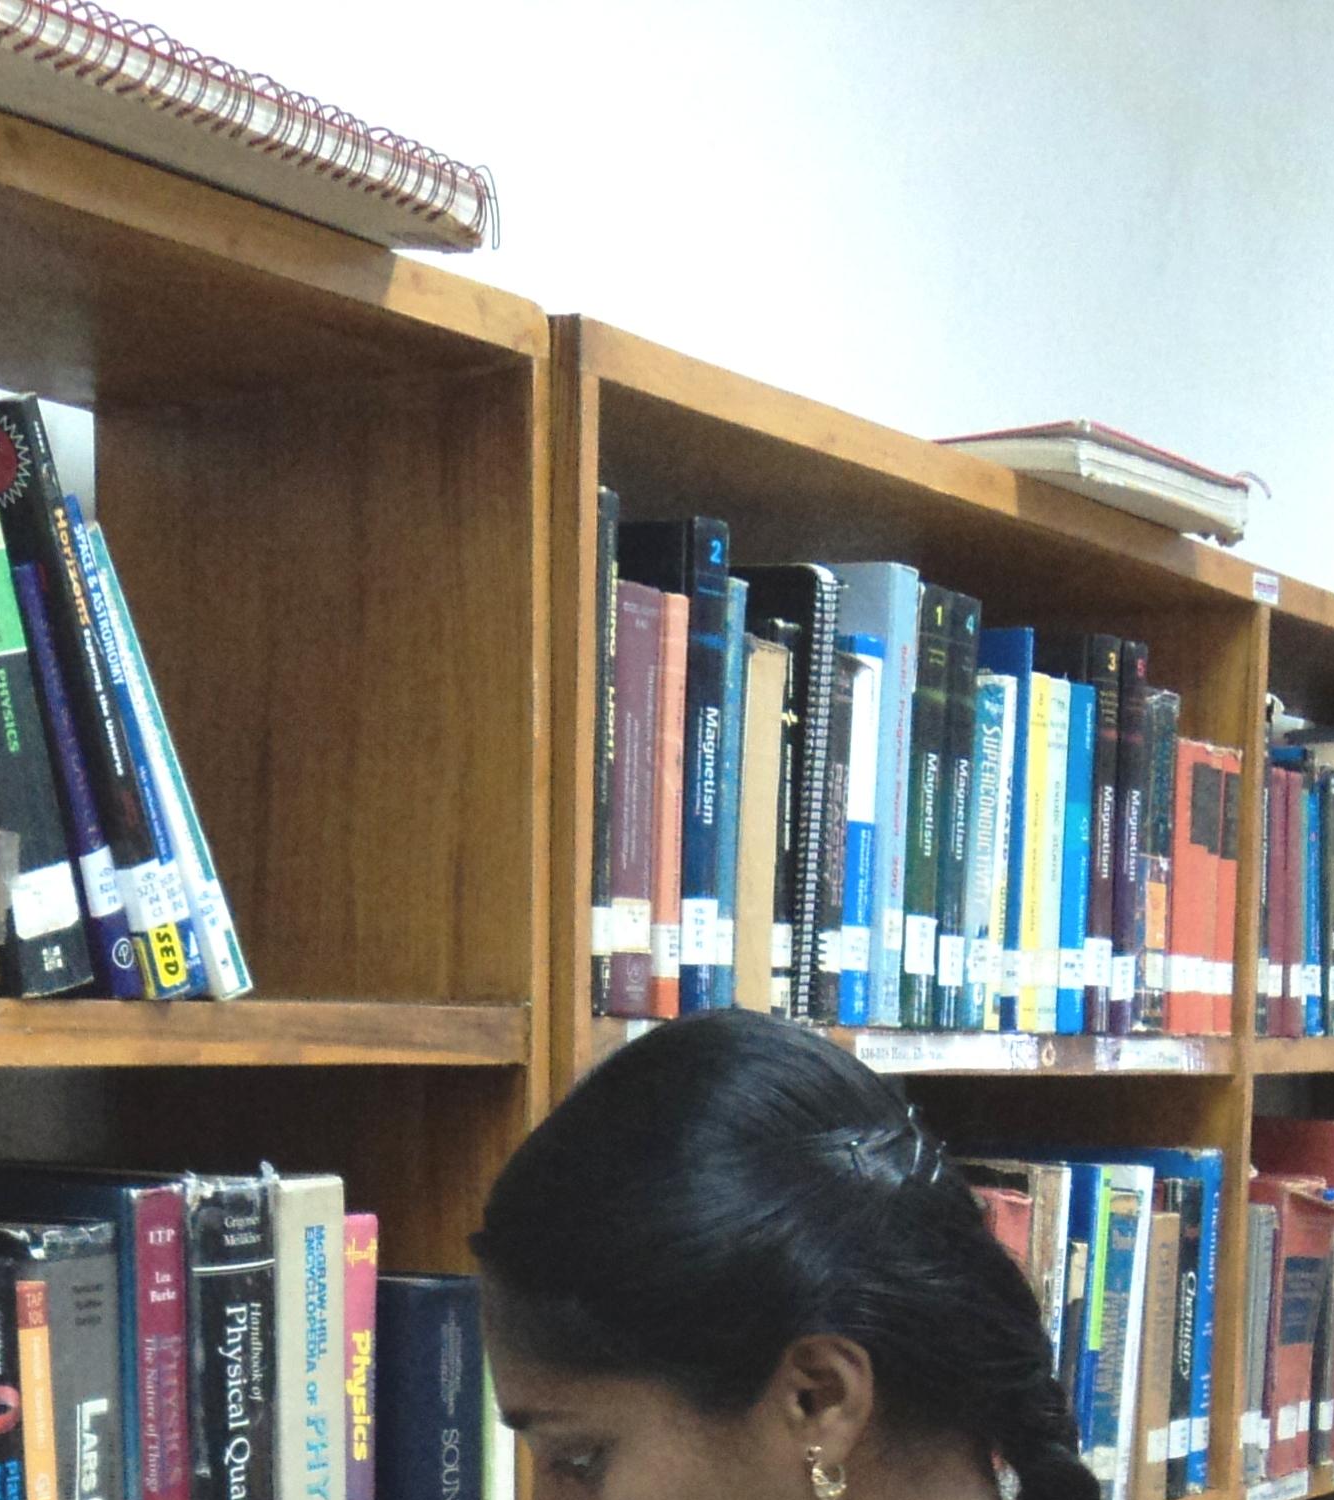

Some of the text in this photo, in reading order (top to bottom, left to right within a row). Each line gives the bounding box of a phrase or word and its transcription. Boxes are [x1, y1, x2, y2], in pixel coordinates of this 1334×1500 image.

[710, 539, 723, 564] 2
[53, 507, 91, 627] Horizons
[103, 718, 125, 777] Universe
[72, 523, 94, 572] SPACE
[89, 590, 126, 687] ASTRONOMY
[934, 605, 943, 627] 1
[1107, 652, 1117, 672] 3
[700, 705, 721, 826] Magnetism
[923, 752, 939, 859] Magnetism
[953, 757, 969, 862] Magnetism
[973, 723, 1003, 906] SUPERCONDUCTIVITY
[1096, 784, 1114, 880] Magnetism
[1127, 789, 1141, 883] Magnetism
[147, 1228, 175, 1245] ITP
[149, 1288, 177, 1304] Burke
[249, 1302, 264, 1370] Handbook
[303, 1225, 320, 1374] ENCYCLOPEDIA
[312, 1224, 329, 1360] McGRAW-HILL
[1180, 1269, 1198, 1381] Chemistry
[218, 1303, 249, 1430] Physical
[306, 1380, 318, 1406] OF
[345, 1329, 371, 1463] Physics
[80, 1397, 109, 1493] LARS
